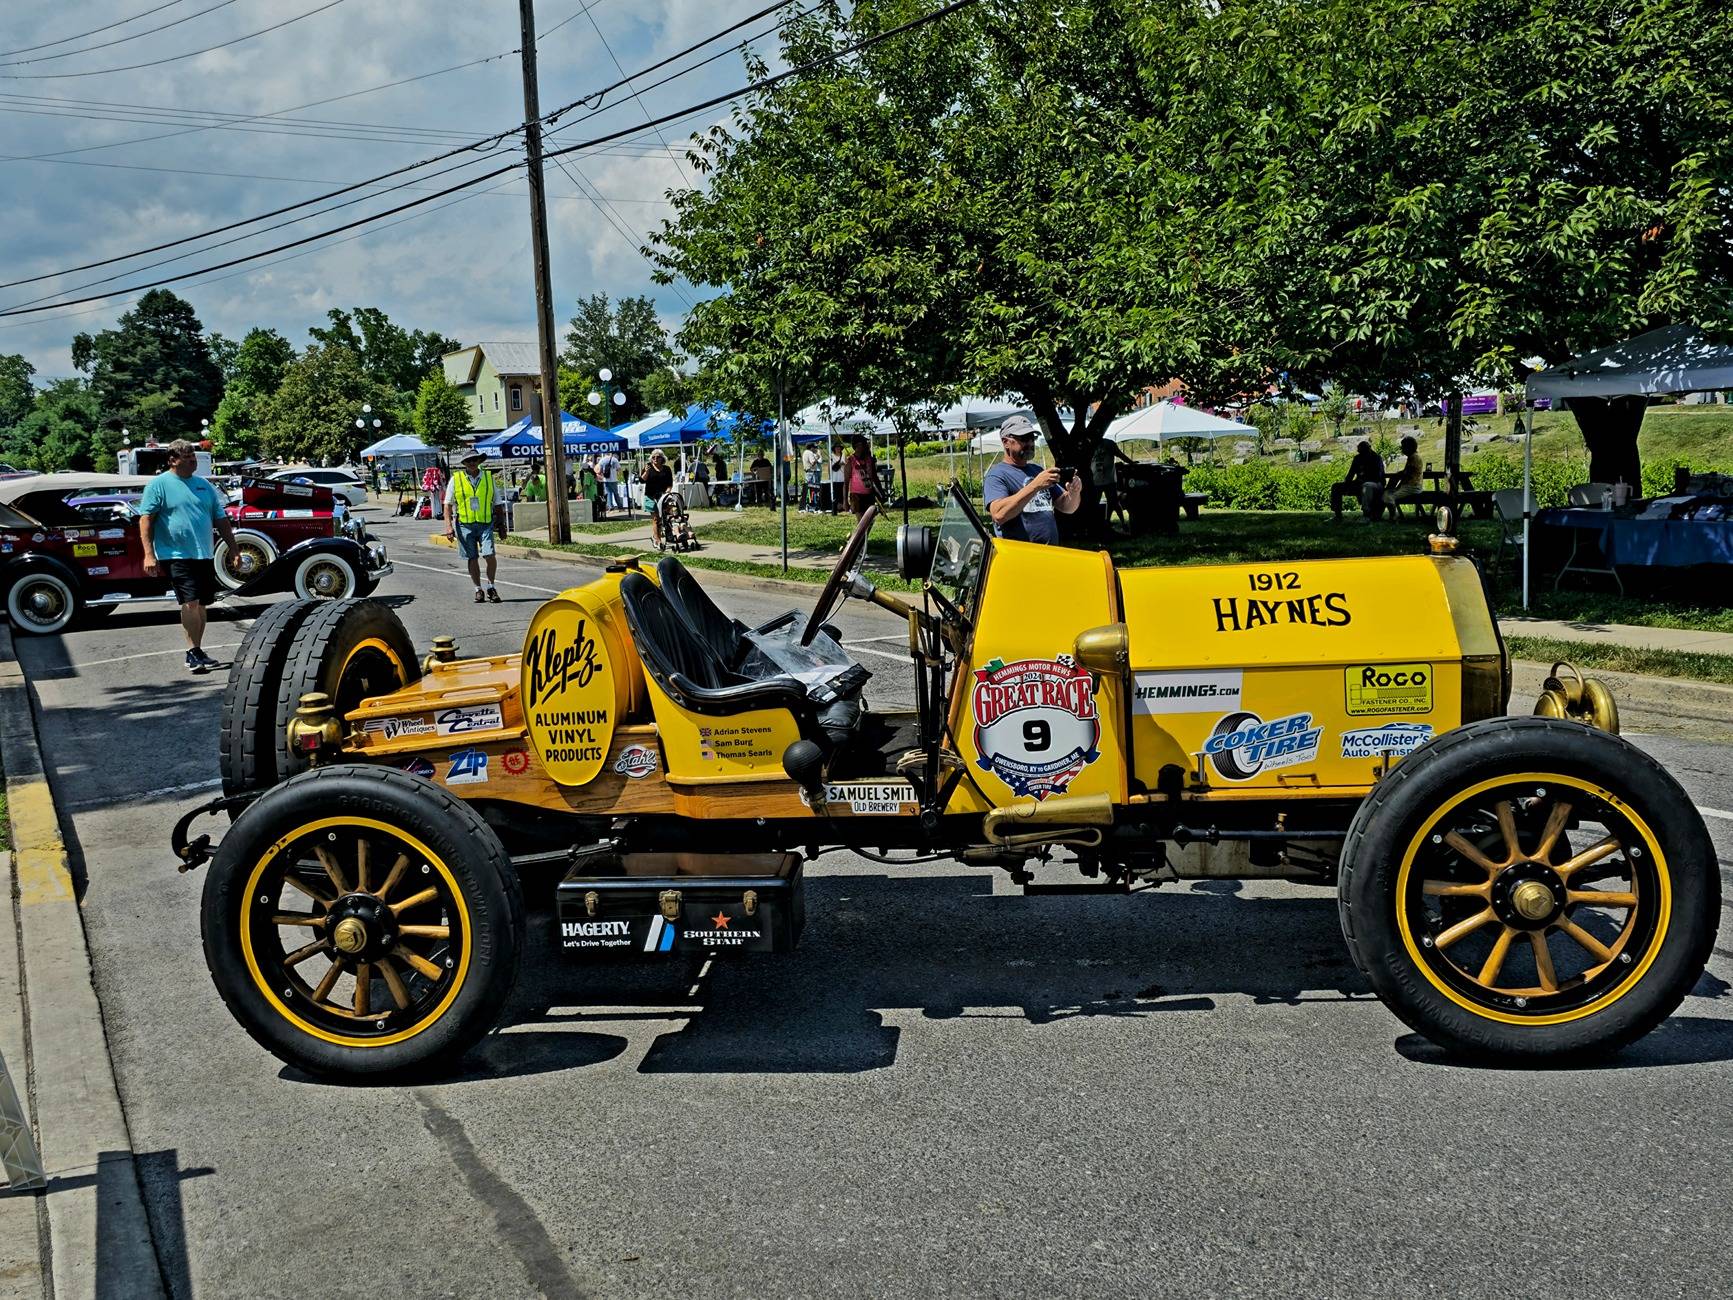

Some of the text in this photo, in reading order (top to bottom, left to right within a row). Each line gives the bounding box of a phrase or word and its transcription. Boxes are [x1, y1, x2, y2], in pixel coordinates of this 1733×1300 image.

[511, 442, 620, 456] COKIRE.COM
[1248, 572, 1302, 591] 1912
[1212, 592, 1352, 633] HAYNES
[526, 619, 602, 709] Kleptz
[993, 663, 1072, 681] HEMMINGS MOTOR NEWS
[1024, 672, 1042, 681] 2024
[974, 678, 1095, 726] GREAT RACE
[1350, 706, 1430, 714] www.ROGOFASTENER.com
[401, 719, 424, 728] Wheel
[437, 708, 496, 724] Corvette
[535, 710, 608, 727] ALUMINUM
[402, 724, 436, 735] Vintiques
[448, 717, 501, 733] Central
[714, 727, 772, 736] Adrian Stevens
[548, 728, 596, 746] VINYL
[1023, 719, 1052, 752] 9
[1204, 714, 1312, 754] COKER
[1342, 733, 1430, 747] McCollister's
[734, 739, 753, 747] Burg
[1243, 728, 1321, 765] TIRE
[545, 746, 602, 763] PRODUCTS
[716, 749, 773, 759] Thomas Searls
[1342, 748, 1370, 757] Auto
[446, 748, 488, 779] Zip
[994, 756, 1029, 773] OWENSBORO,
[1043, 757, 1072, 773] GARDINER,
[1264, 758, 1294, 770] Wheels
[829, 787, 880, 801] SAMUEL
[563, 938, 631, 948] Let's Drive Together
